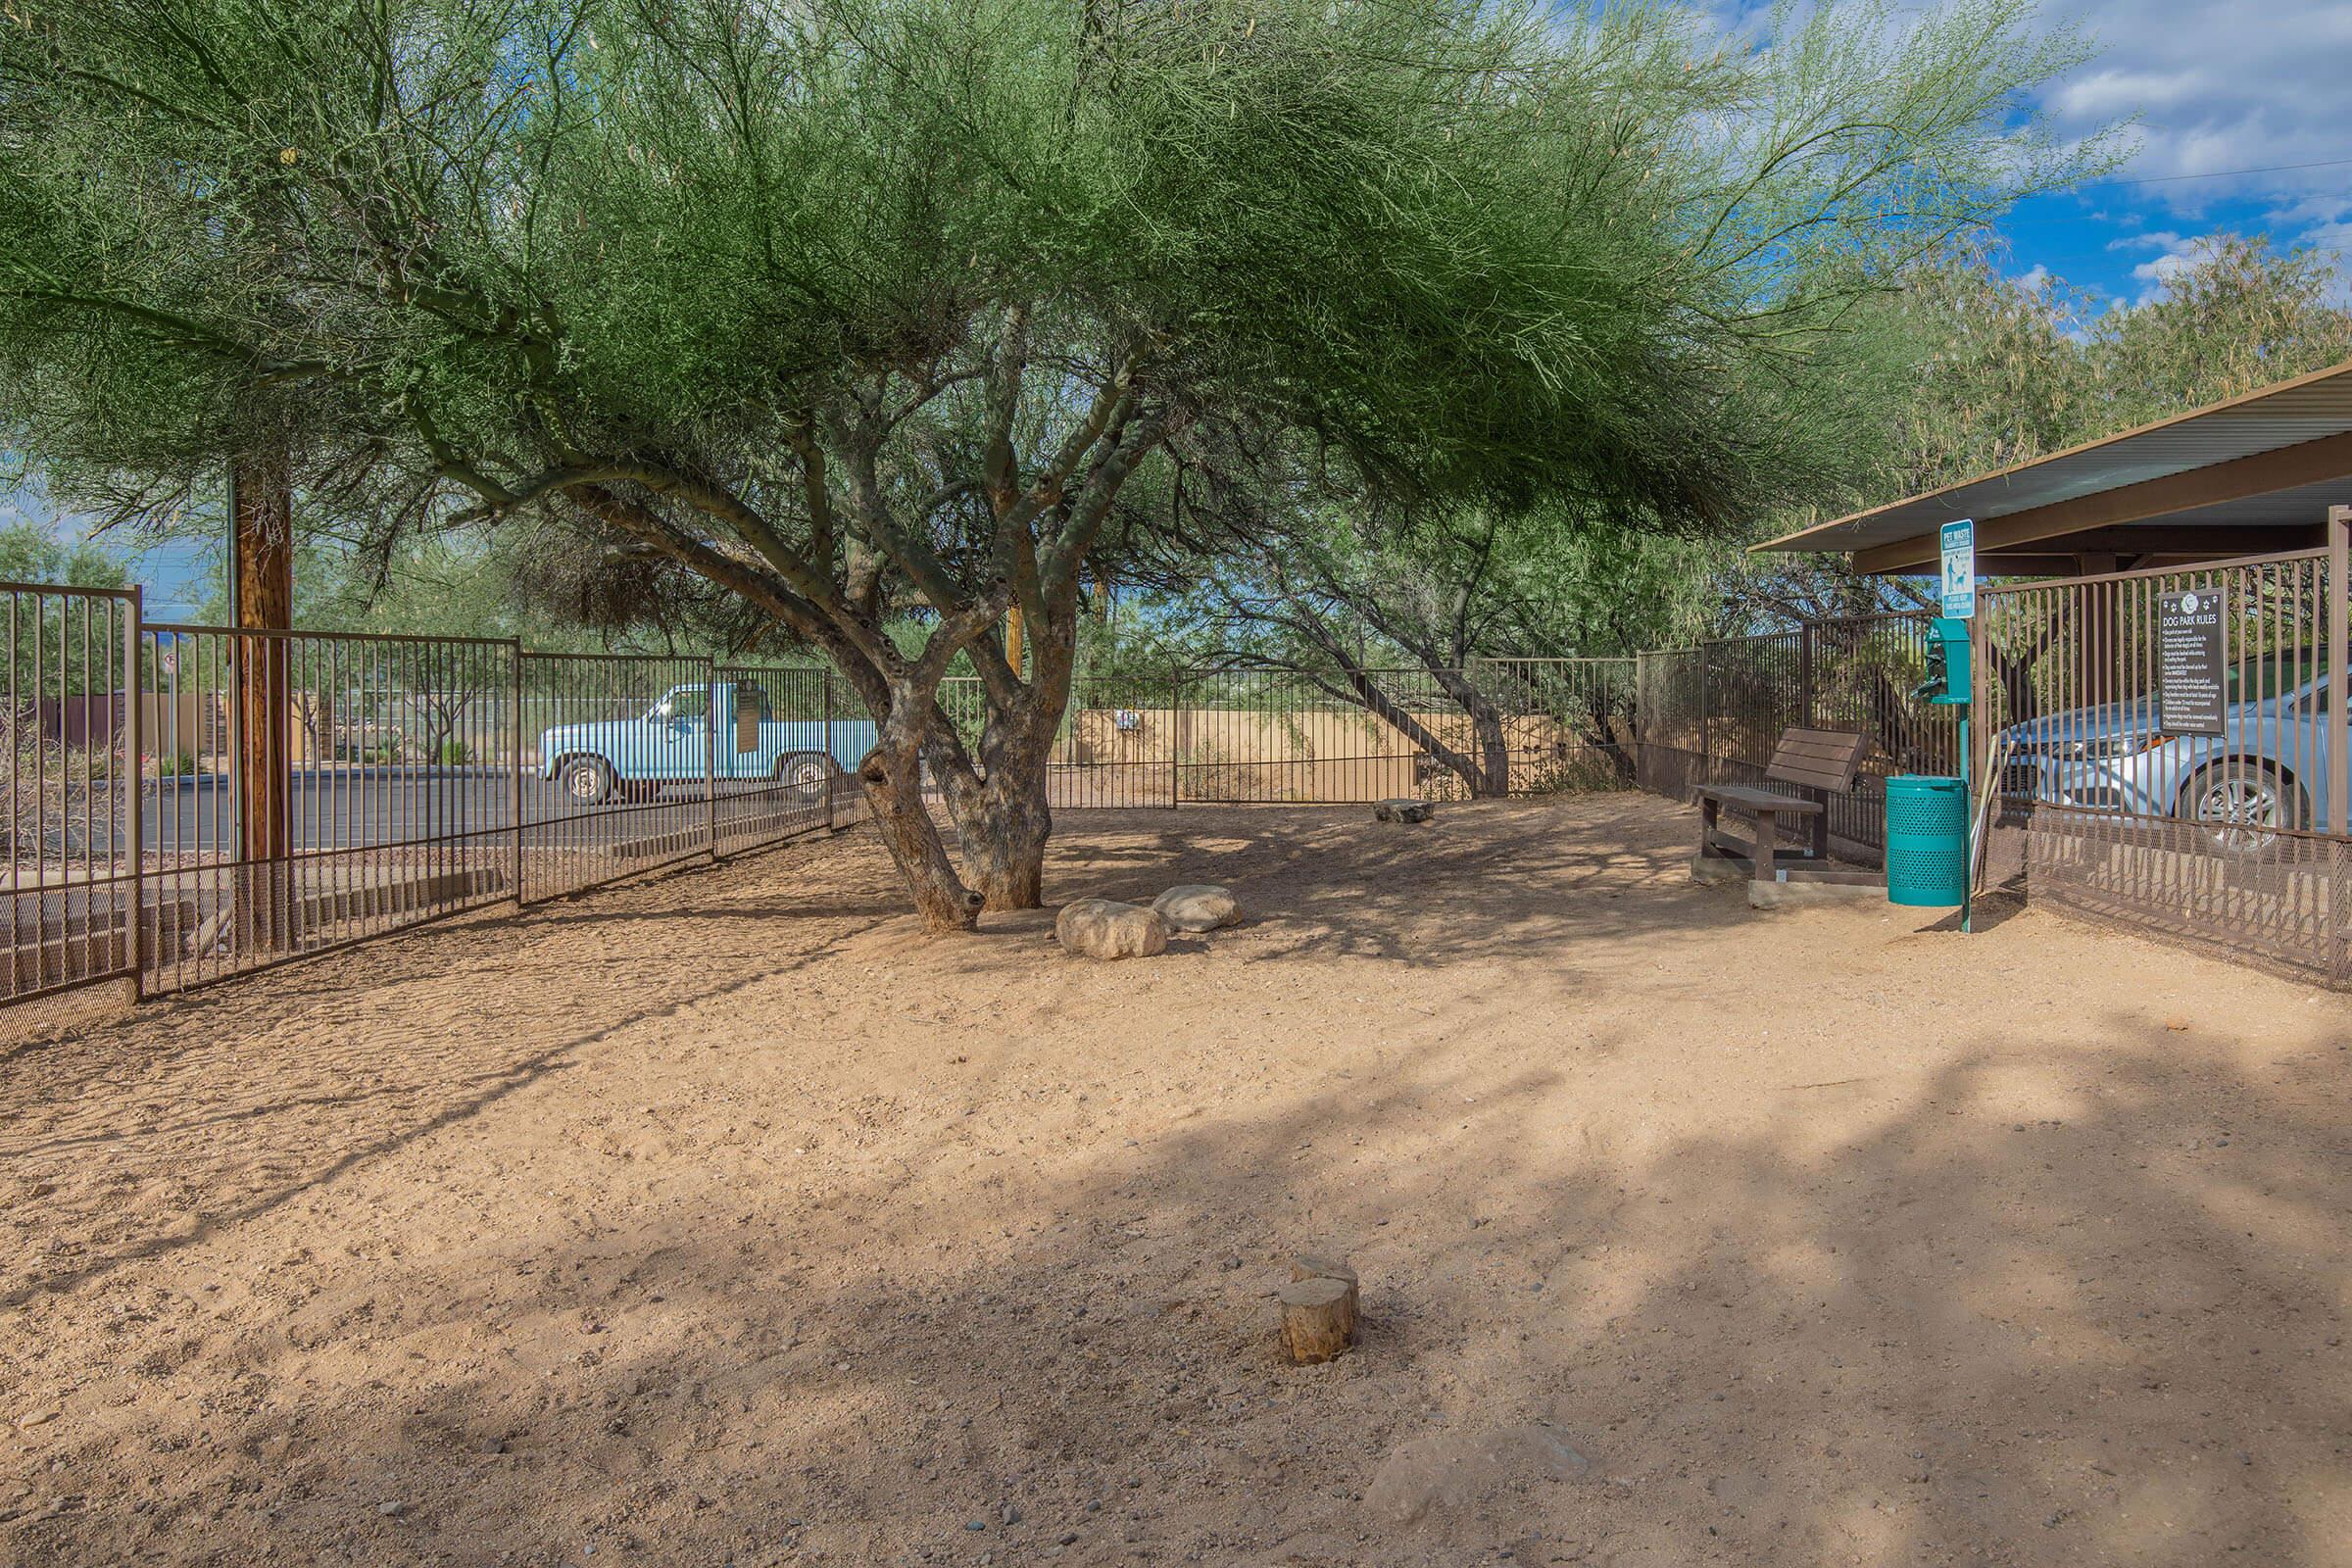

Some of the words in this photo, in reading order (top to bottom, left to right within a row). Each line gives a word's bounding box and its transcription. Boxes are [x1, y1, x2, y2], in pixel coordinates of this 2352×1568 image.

[1944, 531, 1953, 541] PET
[2163, 617, 2179, 627] DOG
[2180, 615, 2195, 626] PARK
[2196, 614, 2217, 625] RULES
